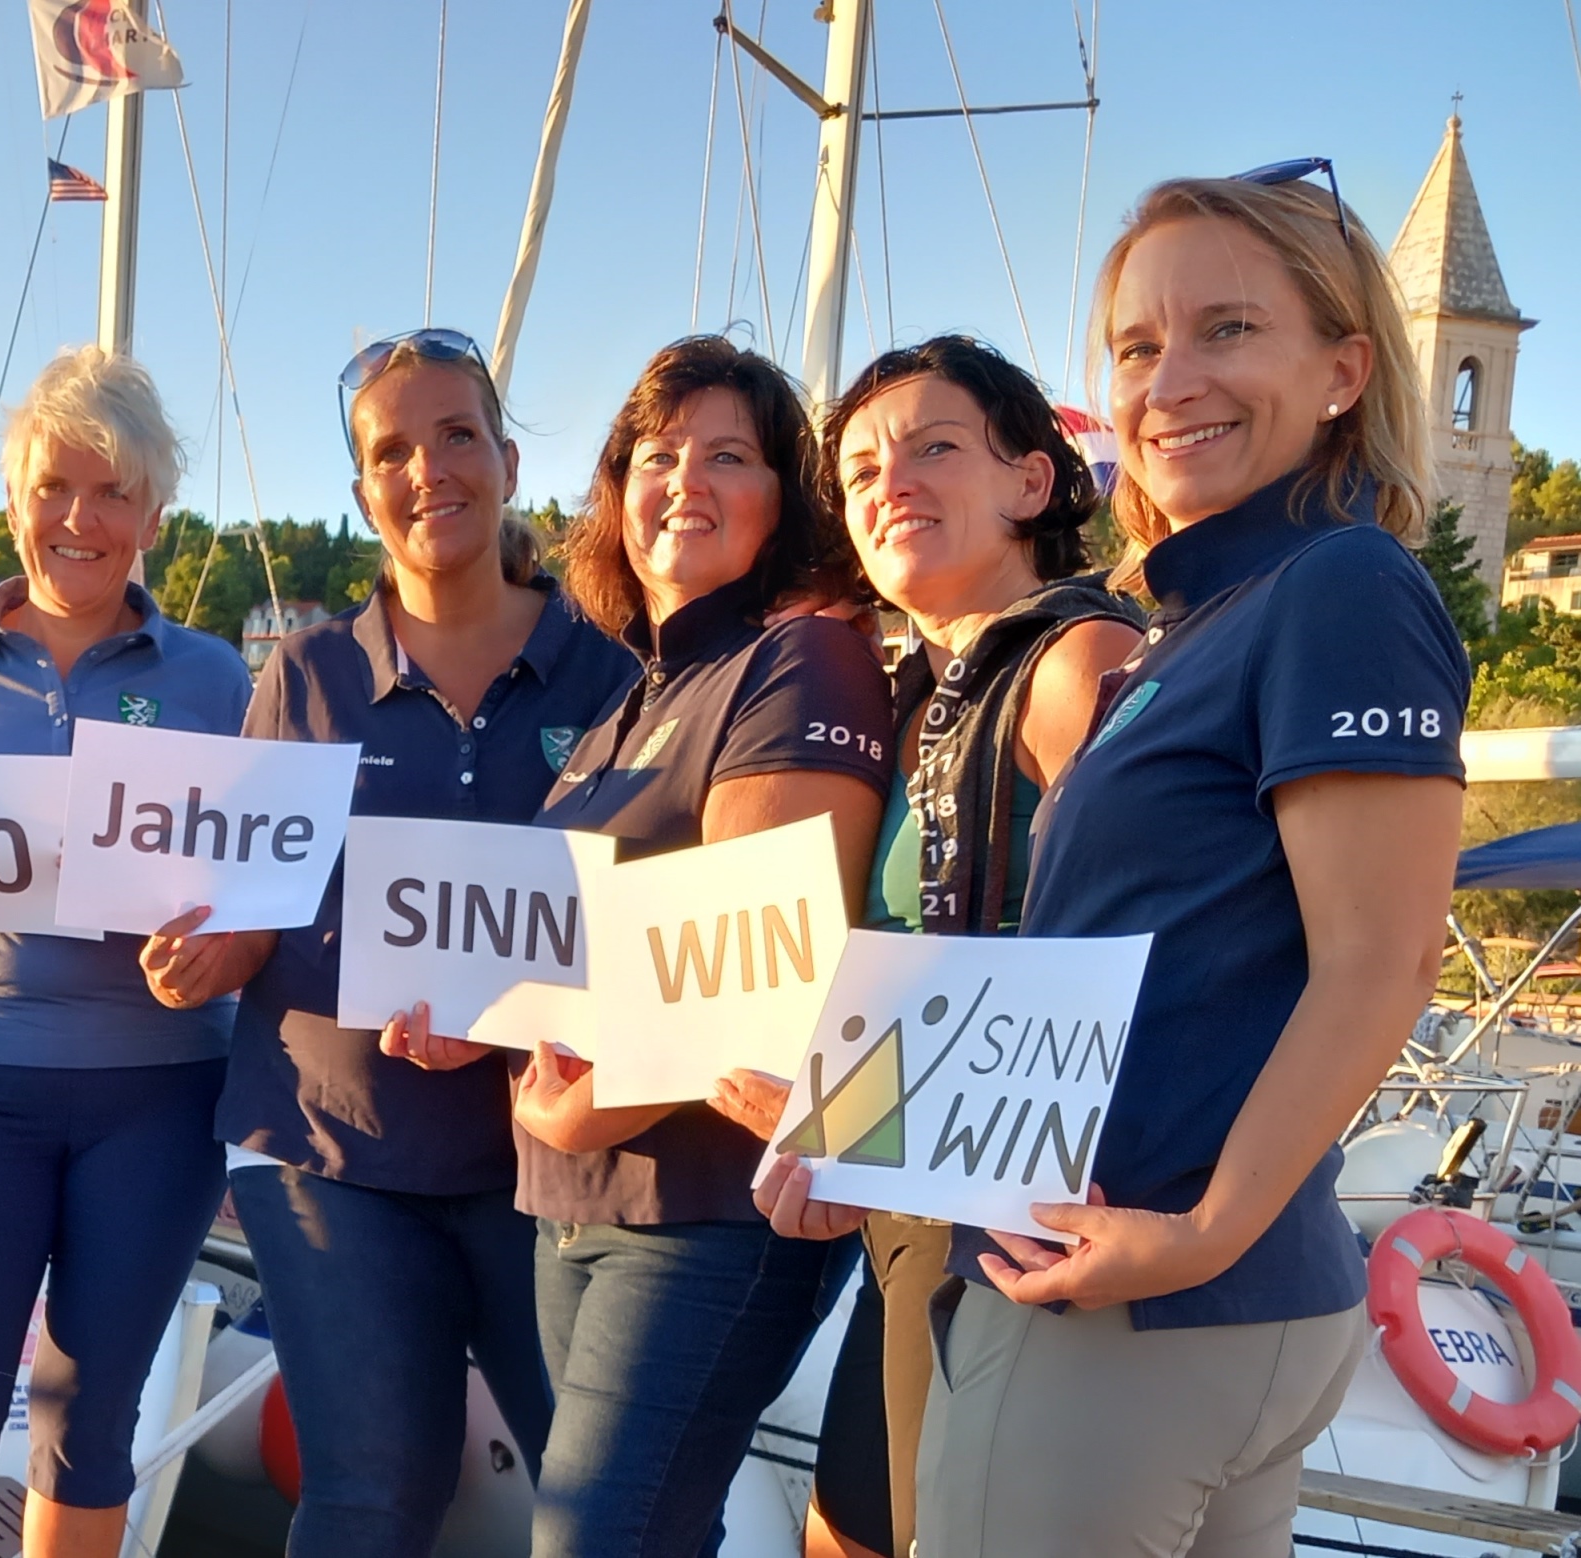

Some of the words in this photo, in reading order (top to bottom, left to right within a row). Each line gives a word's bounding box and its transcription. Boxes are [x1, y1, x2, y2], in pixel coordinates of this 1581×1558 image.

[804, 721, 883, 762] 2018
[1330, 706, 1442, 739] 2018
[360, 755, 395, 766] niela
[92, 781, 314, 863] Jahre
[383, 876, 578, 968] SINN
[646, 898, 815, 1004] WIN
[968, 1014, 1127, 1086] SINN
[928, 1092, 1101, 1195] WIN
[1427, 1328, 1514, 1368] EBRA
